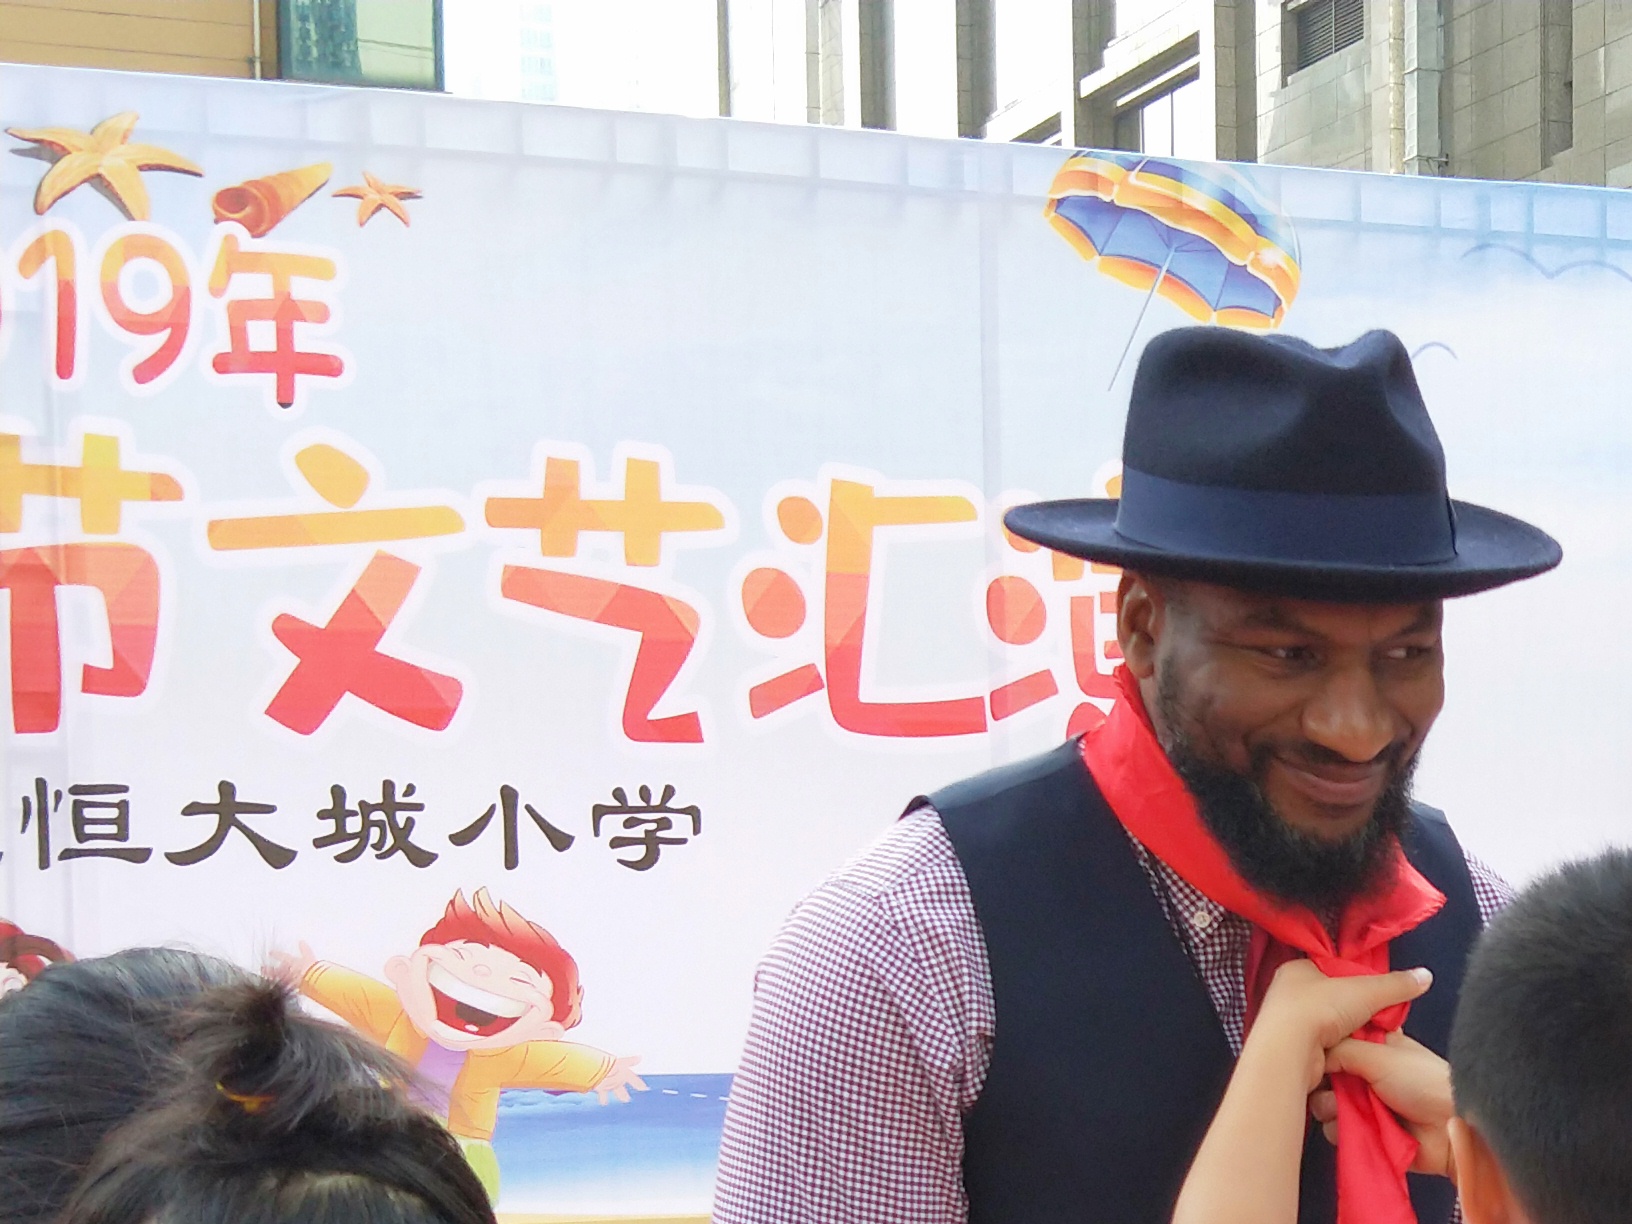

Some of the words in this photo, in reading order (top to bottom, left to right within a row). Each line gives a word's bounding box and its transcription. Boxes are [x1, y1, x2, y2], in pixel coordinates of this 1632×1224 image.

[0, 230, 345, 408] 19年
[0, 778, 702, 871] 恒大城小学
